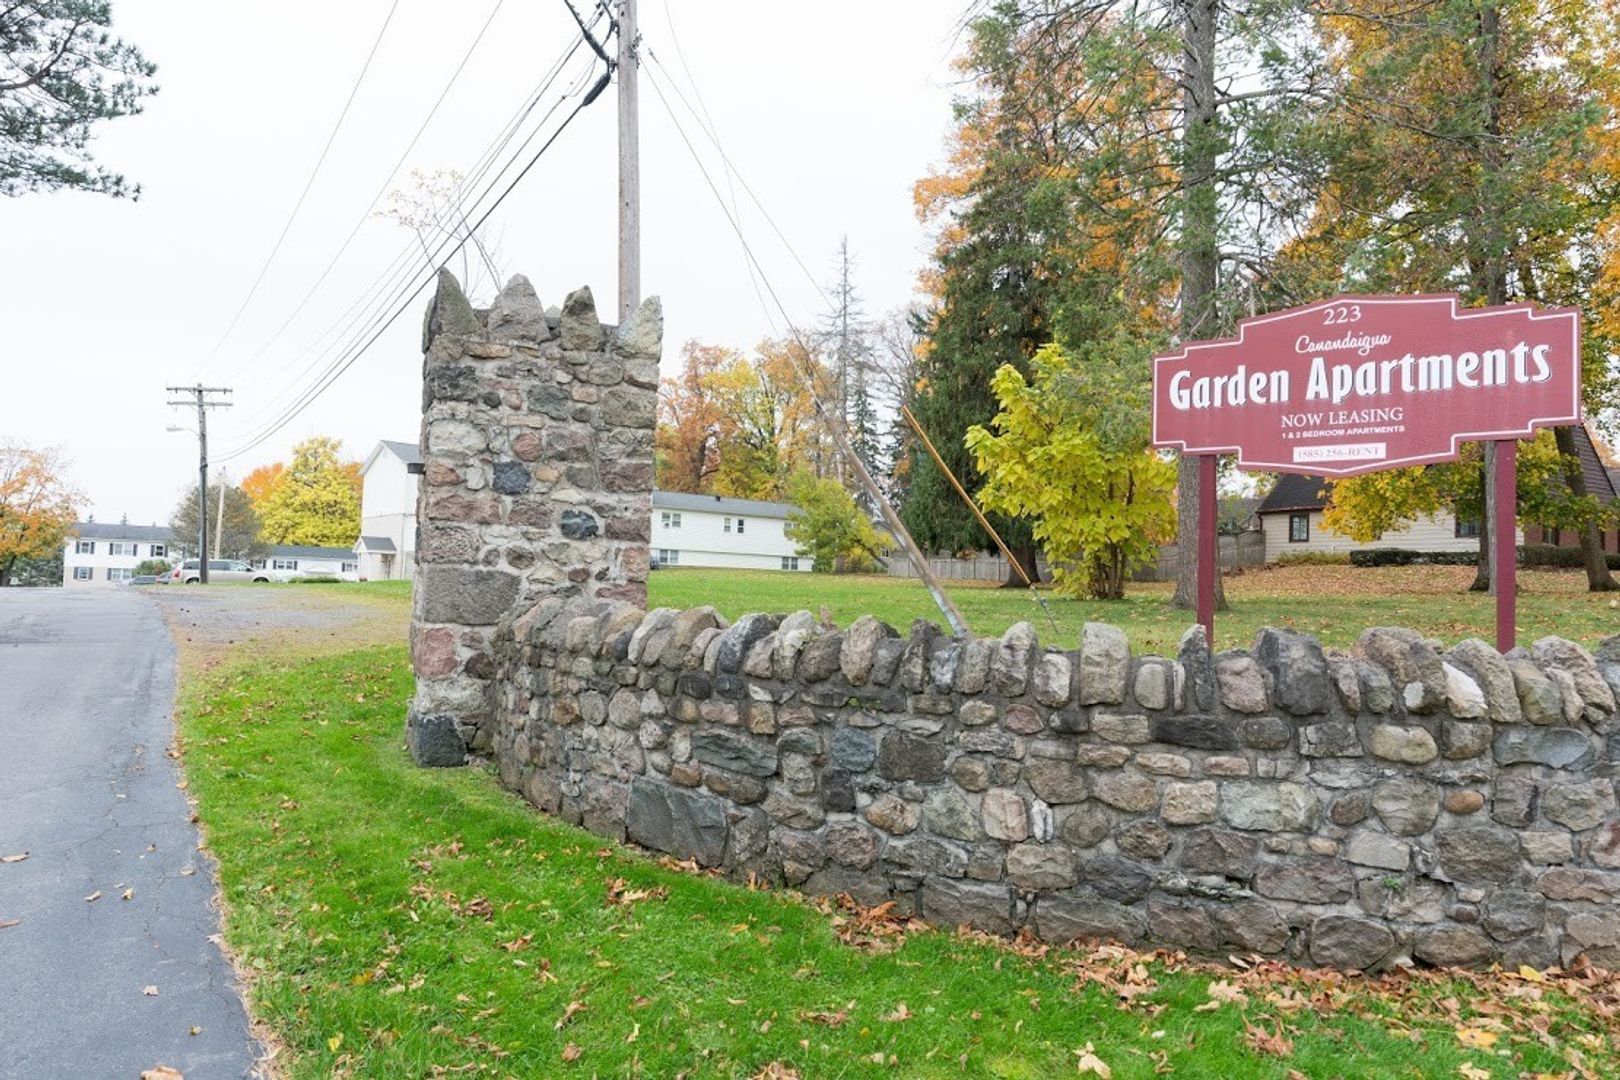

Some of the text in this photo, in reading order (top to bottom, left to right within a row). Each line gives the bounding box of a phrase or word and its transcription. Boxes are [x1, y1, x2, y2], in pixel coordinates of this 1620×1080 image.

[1322, 305, 1362, 325] 223
[1295, 330, 1392, 356] Canandaigua
[1169, 341, 1553, 411] Garden Apartments
[1281, 407, 1405, 428] NOW LEASING
[1288, 431, 1295, 439] &
[1302, 428, 1345, 438] BEDROOM
[1346, 424, 1406, 436] APARTMENTS
